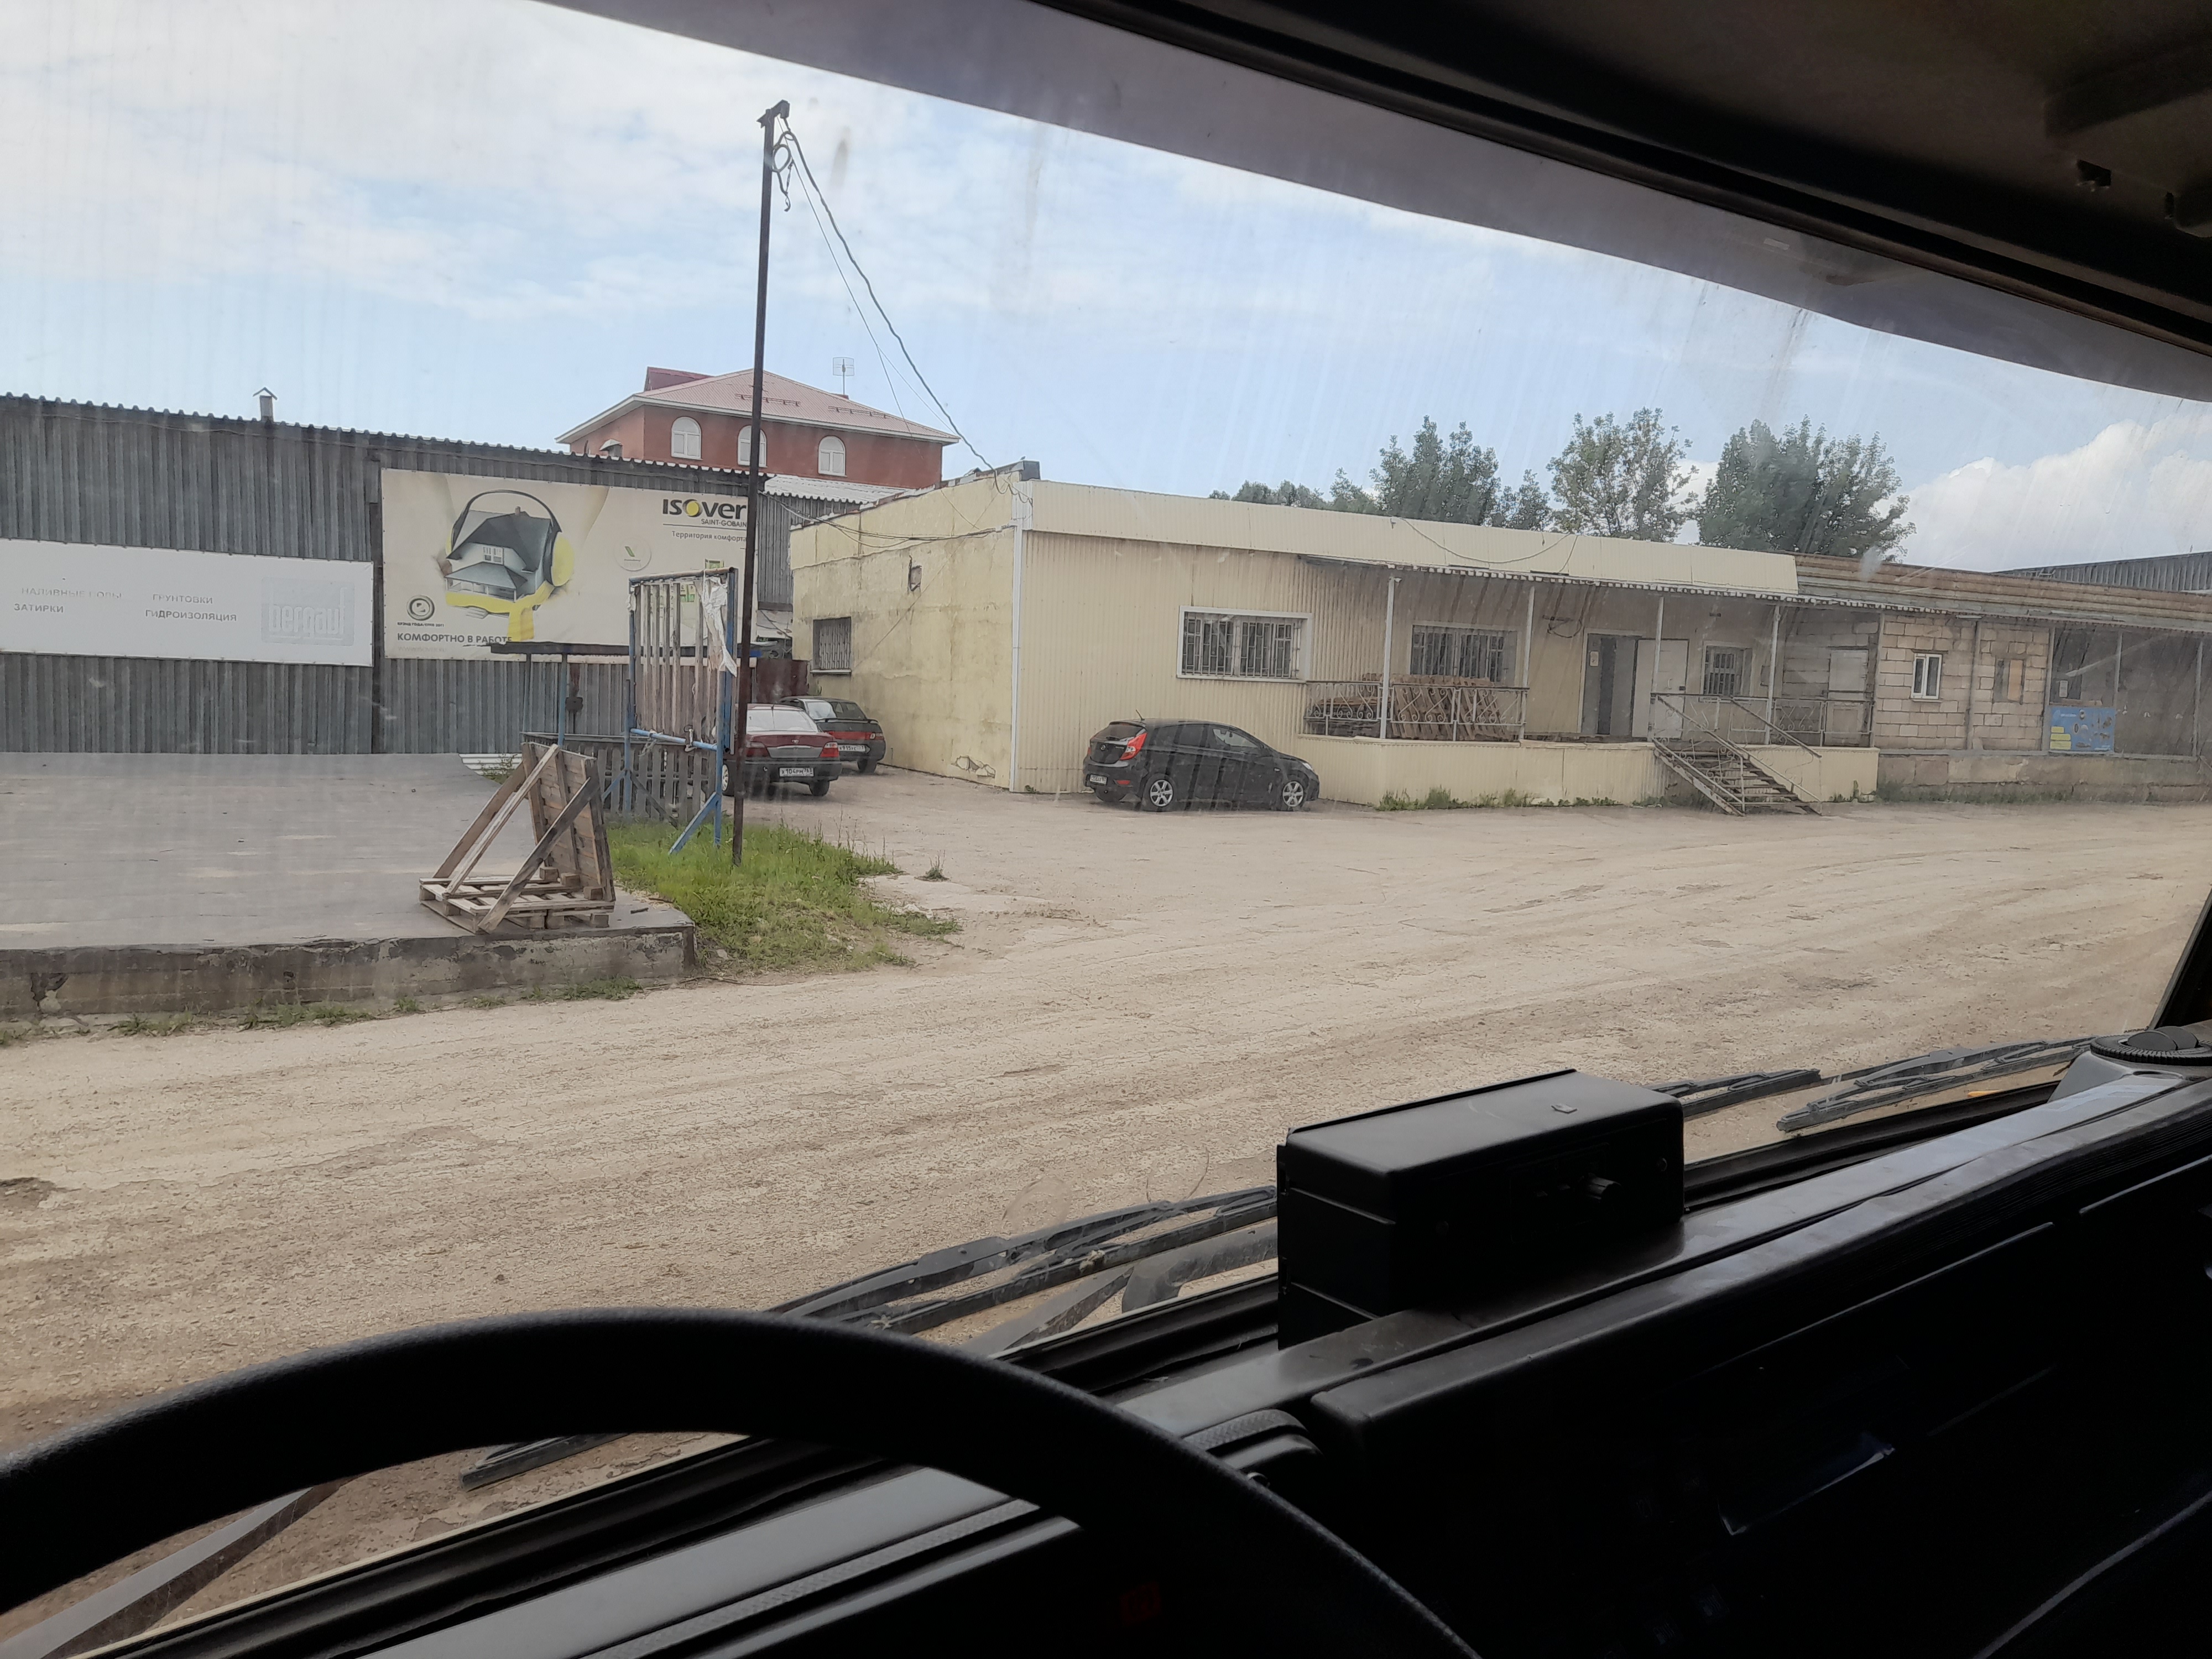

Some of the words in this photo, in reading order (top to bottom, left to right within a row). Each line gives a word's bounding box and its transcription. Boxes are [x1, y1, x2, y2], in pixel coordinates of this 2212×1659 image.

[701, 518, 747, 527] SAINT-GOBAIN
[672, 530, 712, 540] Территория
[152, 593, 213, 604] ГРУНТОВКИ
[14, 603, 64, 613] ЗАТИРКИ
[145, 609, 237, 622] ГИДРОИЗОЛЯЦИЯ
[397, 633, 465, 643] КОМФОРТНО
